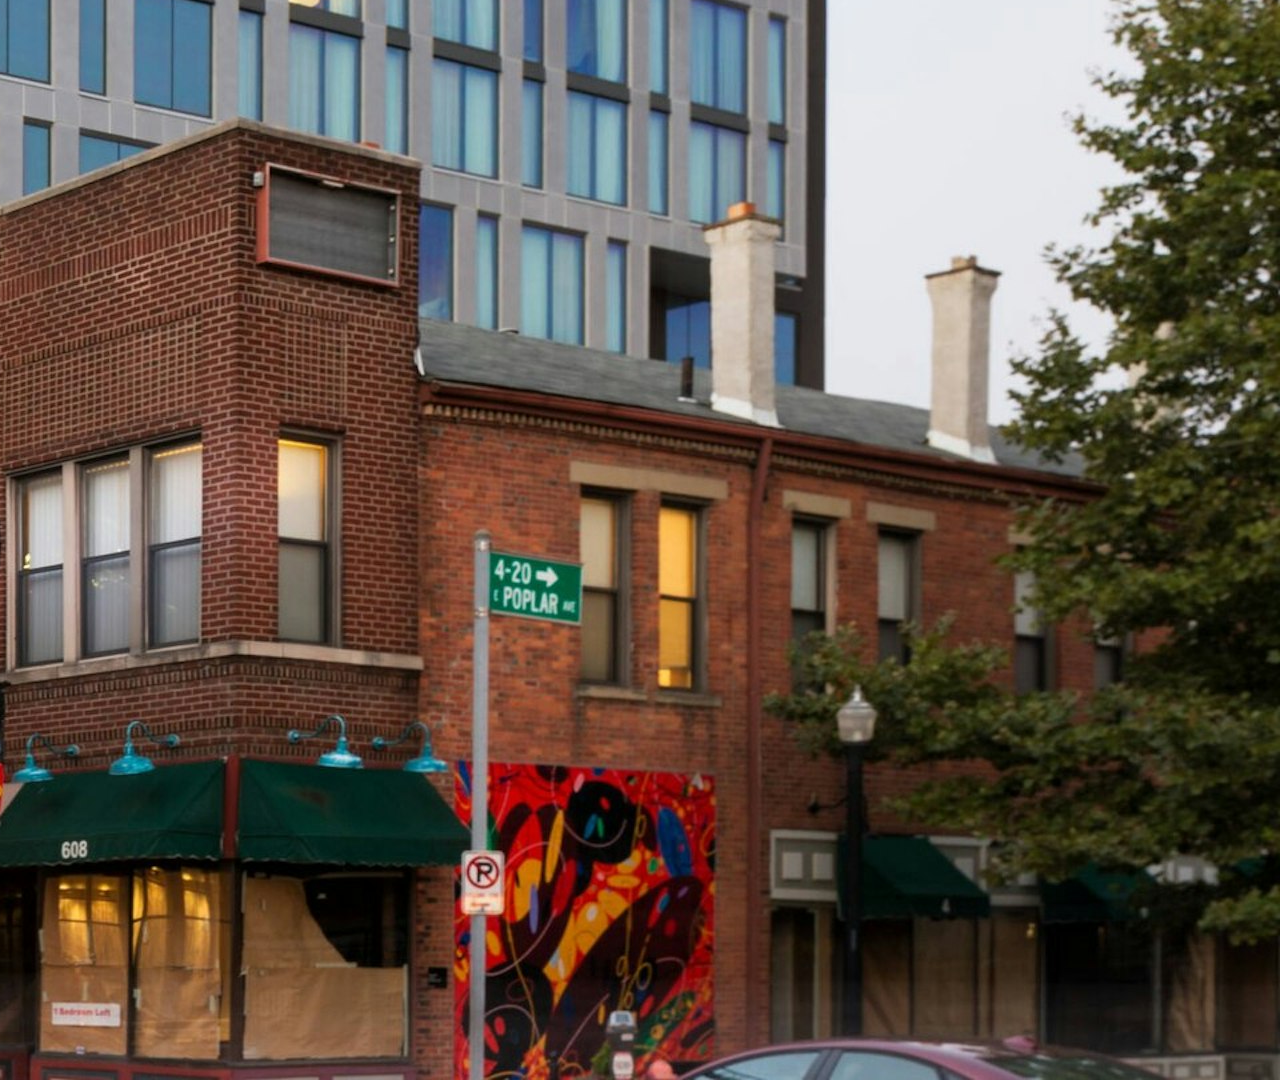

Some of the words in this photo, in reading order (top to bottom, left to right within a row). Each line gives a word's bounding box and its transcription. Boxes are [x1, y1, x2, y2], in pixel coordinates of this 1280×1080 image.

[494, 558, 532, 585] 4-20
[502, 586, 559, 615] POPLAR
[61, 840, 88, 859] 608
[60, 1008, 93, 1016] Bedroom
